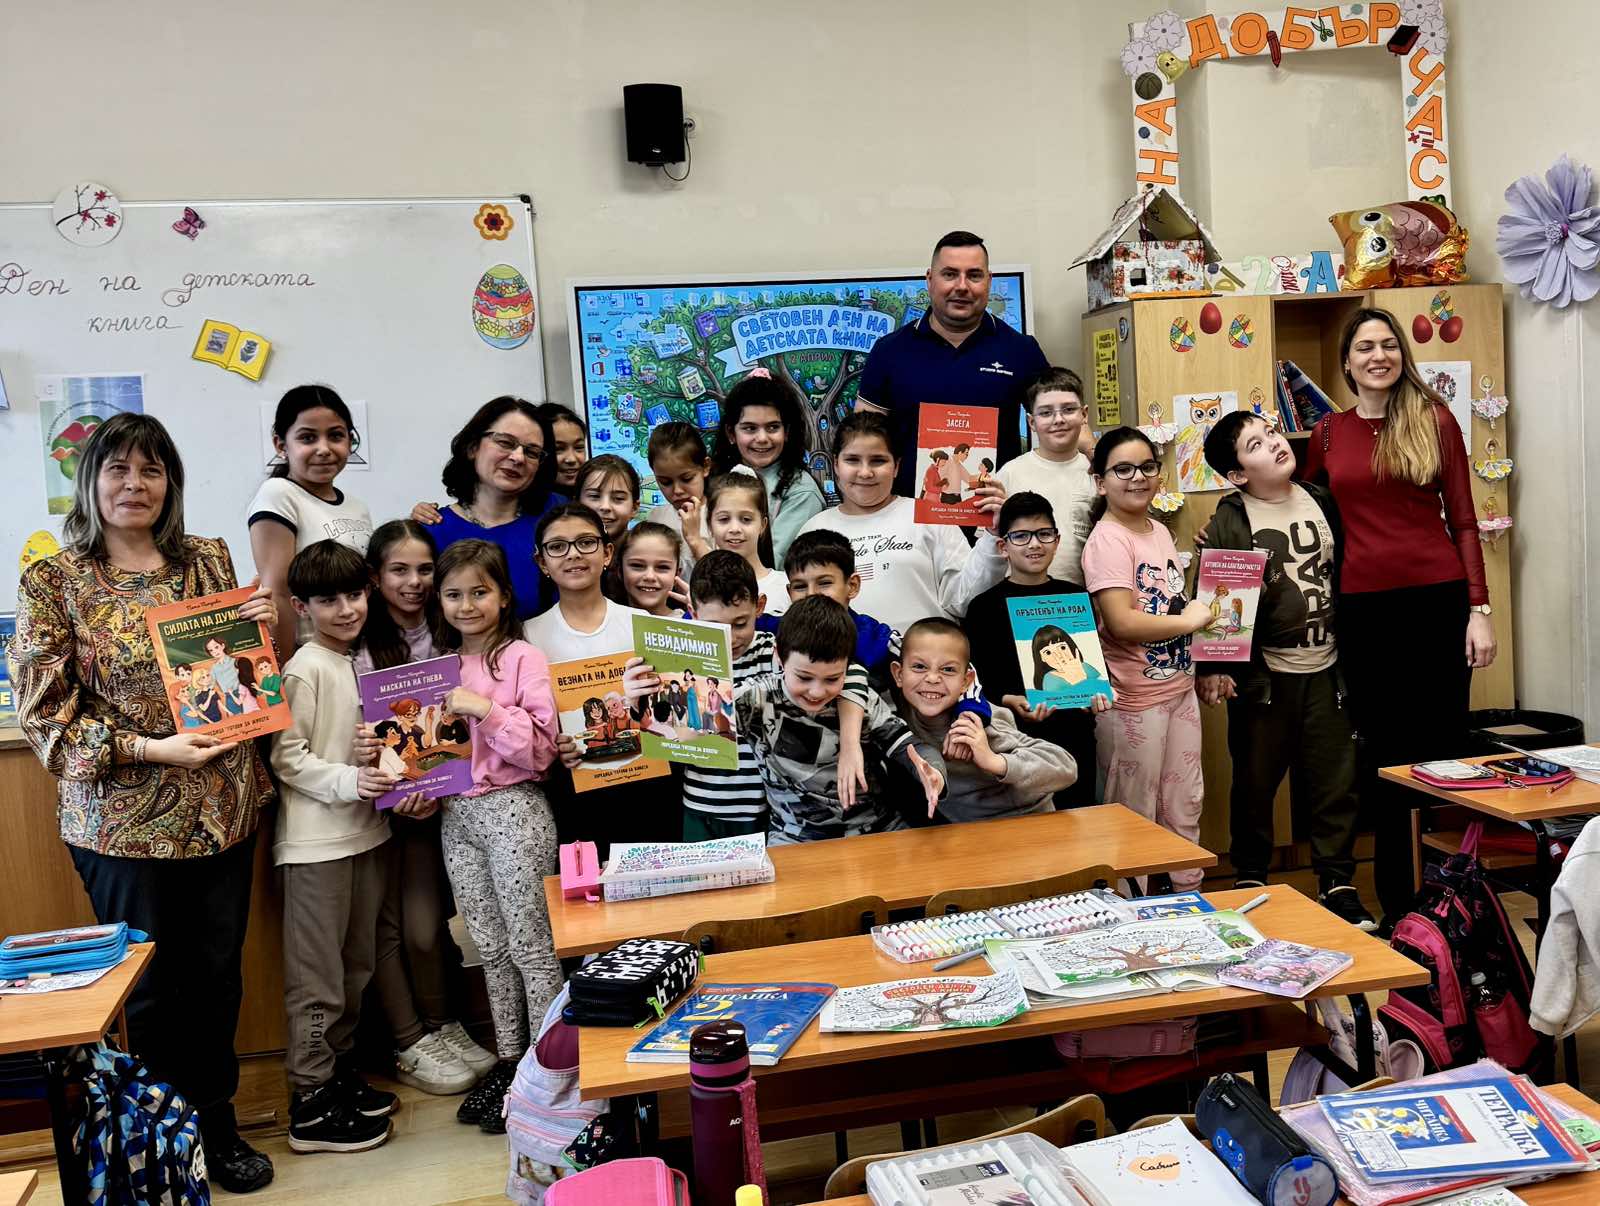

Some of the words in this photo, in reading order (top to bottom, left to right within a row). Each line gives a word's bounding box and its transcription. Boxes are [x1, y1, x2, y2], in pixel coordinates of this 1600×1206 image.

[1134, 96, 1180, 186] НА
[1185, 2, 1402, 70] ДОБЪР
[1406, 47, 1448, 191] ЧАС
[0, 262, 72, 297] Ден
[99, 272, 142, 292] на
[161, 272, 316, 308] детската
[88, 314, 185, 333] книга
[737, 309, 824, 338] СВЕТОВЕН
[828, 309, 864, 329] ДЕН
[866, 314, 889, 335] НА
[744, 328, 828, 360] ДЕТСКАТА
[832, 329, 880, 350] КНИГ
[946, 418, 971, 429] ЗАСЕГА
[873, 534, 913, 555] State
[1057, 606, 1067, 614] НА
[1068, 605, 1087, 614] РОДА
[163, 617, 201, 637] СИЛАТА
[200, 614, 216, 629] НА
[643, 631, 719, 657] НЕВИДИМИЯТ
[379, 680, 411, 694] МАСКАТА
[412, 677, 422, 686] НА
[423, 673, 443, 684] ГНЕВА
[557, 673, 594, 687] ВЕЗНАТА
[594, 670, 606, 681] НА
[1415, 1099, 1451, 1143] ЧИТАНКА
[1478, 1089, 1542, 1155] ТЕТРАДКА
